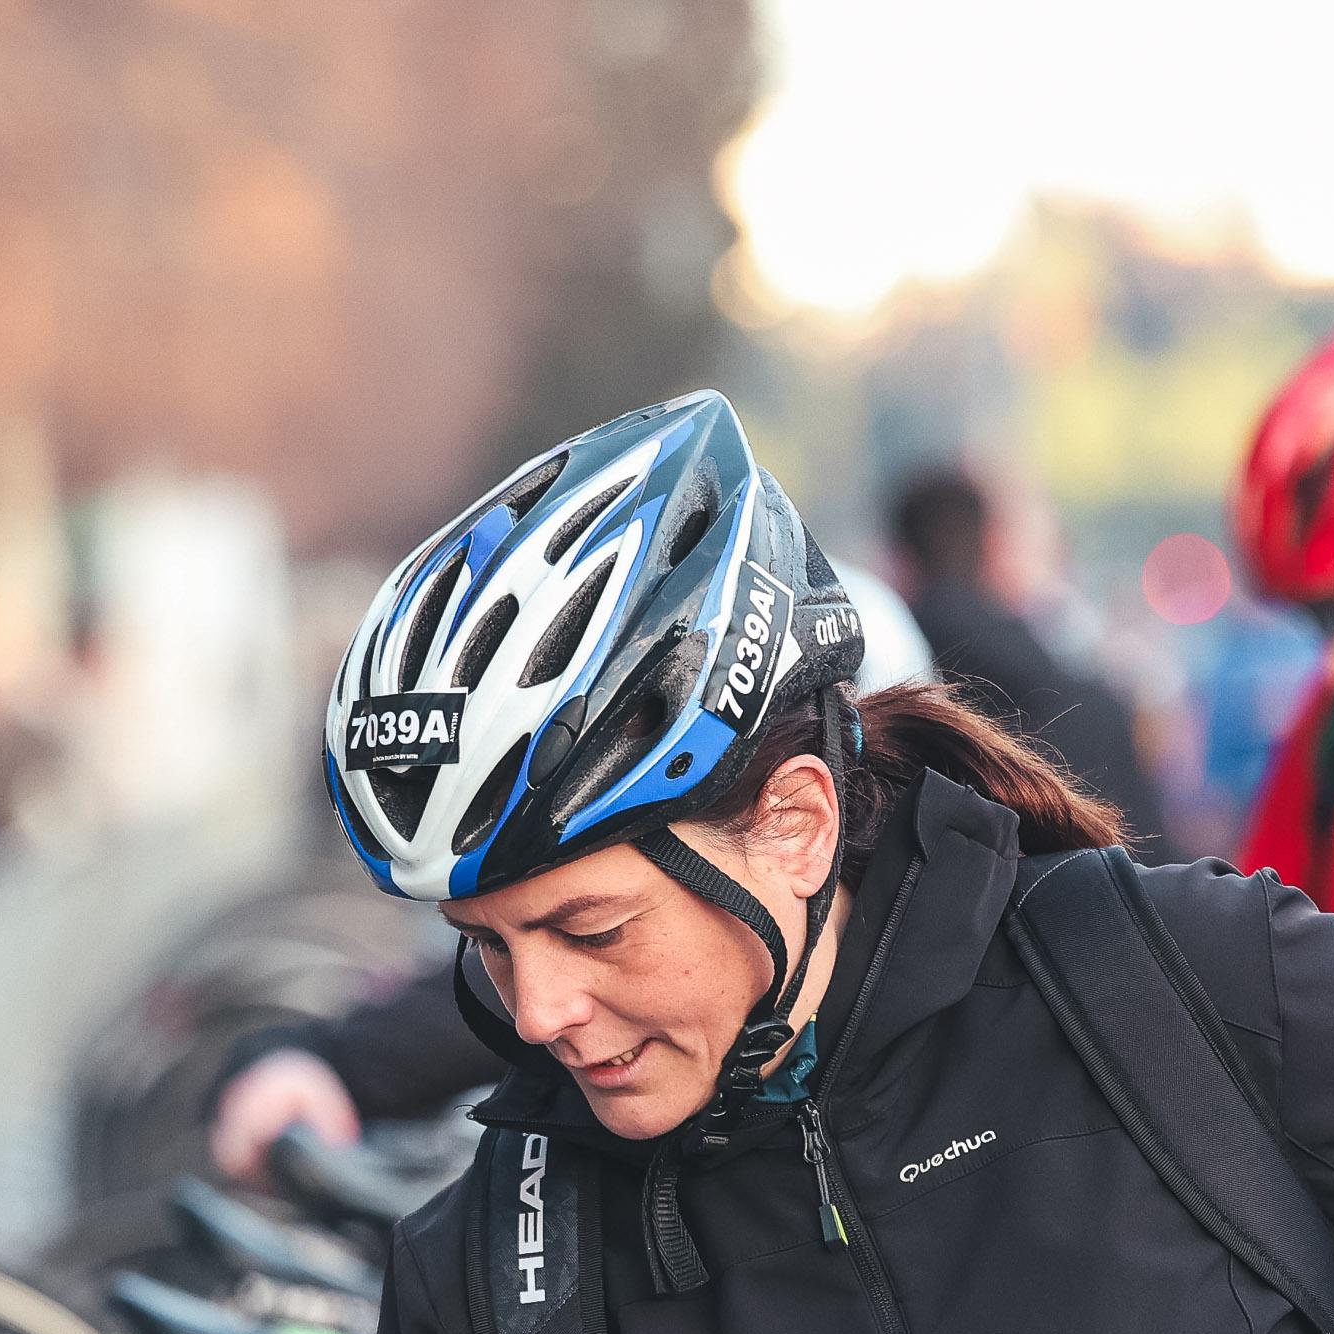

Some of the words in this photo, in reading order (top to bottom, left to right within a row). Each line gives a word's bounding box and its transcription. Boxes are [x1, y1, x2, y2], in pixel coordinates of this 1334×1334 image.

[717, 588, 776, 719] 7039A
[350, 709, 450, 749] 7039A
[899, 1130, 997, 1183] Quechua
[518, 1132, 548, 1304] HEAD
